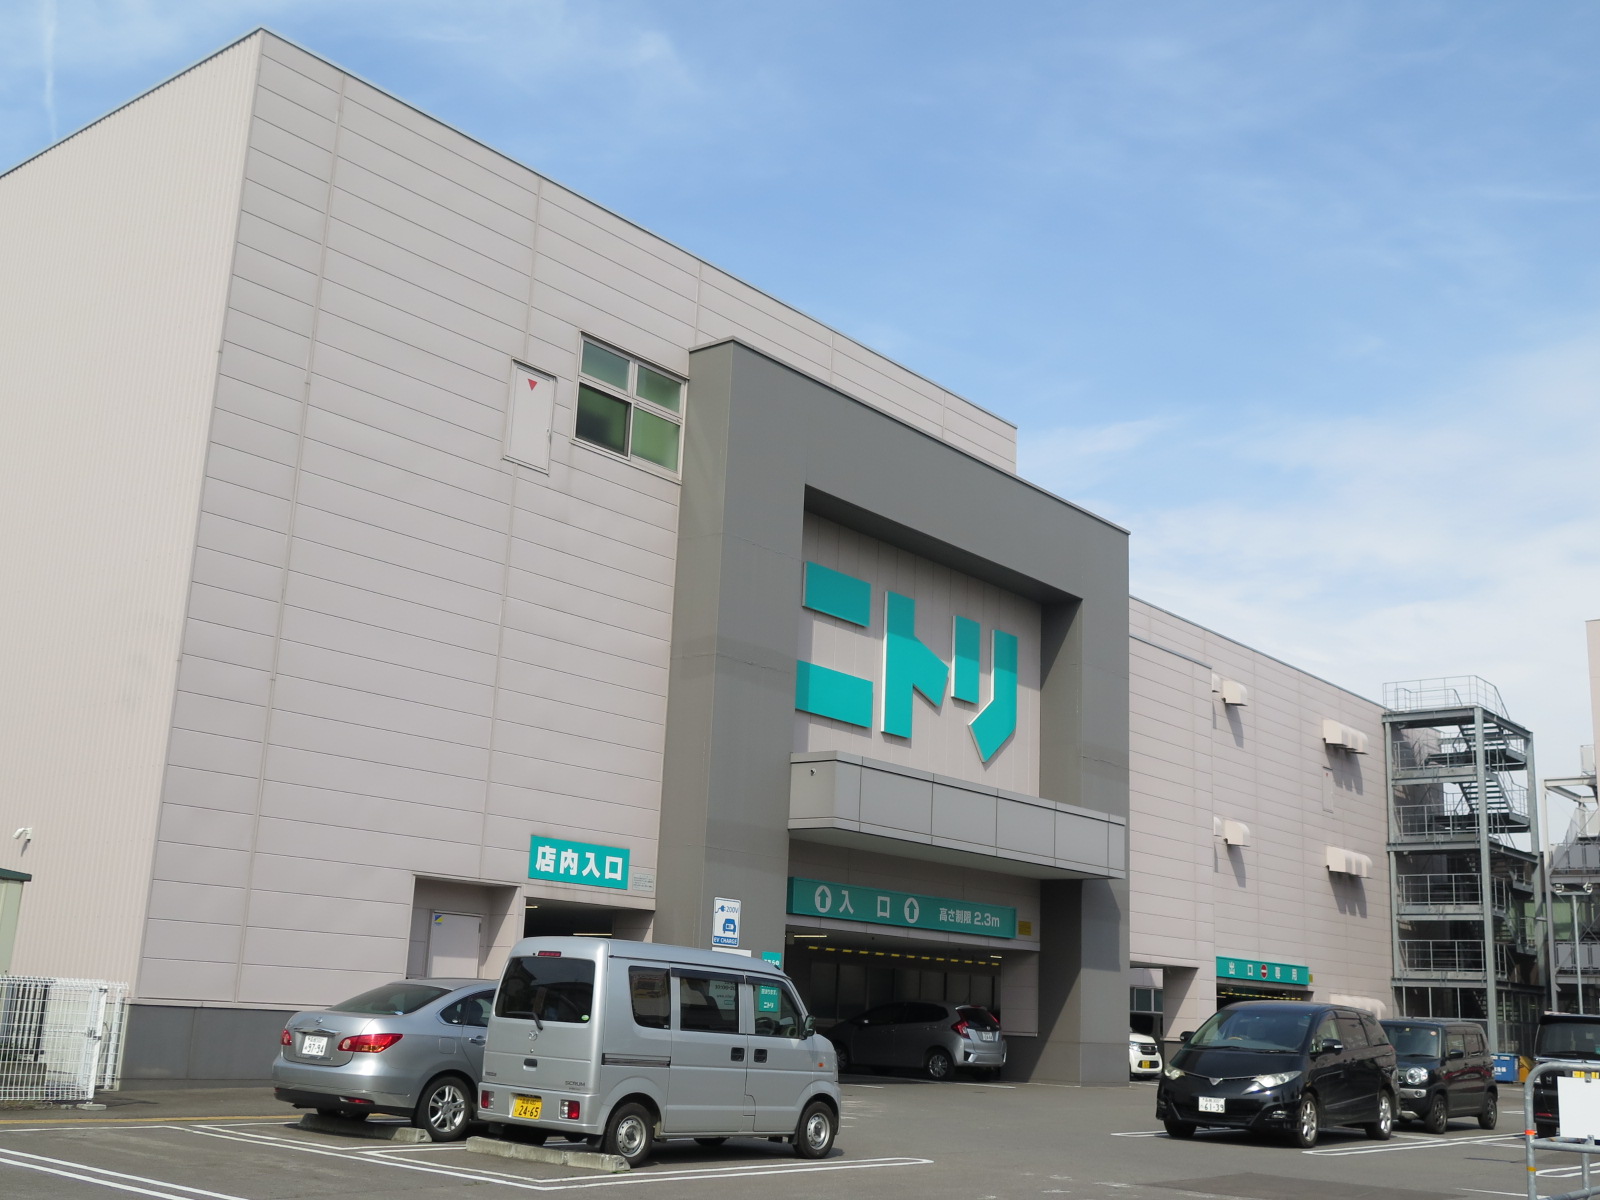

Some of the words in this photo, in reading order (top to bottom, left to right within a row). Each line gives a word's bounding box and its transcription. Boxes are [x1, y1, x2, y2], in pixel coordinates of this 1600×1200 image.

[795, 561, 1018, 763] ニトリ
[535, 845, 623, 880] 店内入口
[726, 905, 739, 914] 200V
[939, 907, 972, 925] 高さ制限
[974, 911, 1000, 928] 2.3m
[721, 937, 738, 945] CHARGE
[518, 1105, 540, 1118] 24-65
[1204, 1102, 1224, 1112] 61-39
